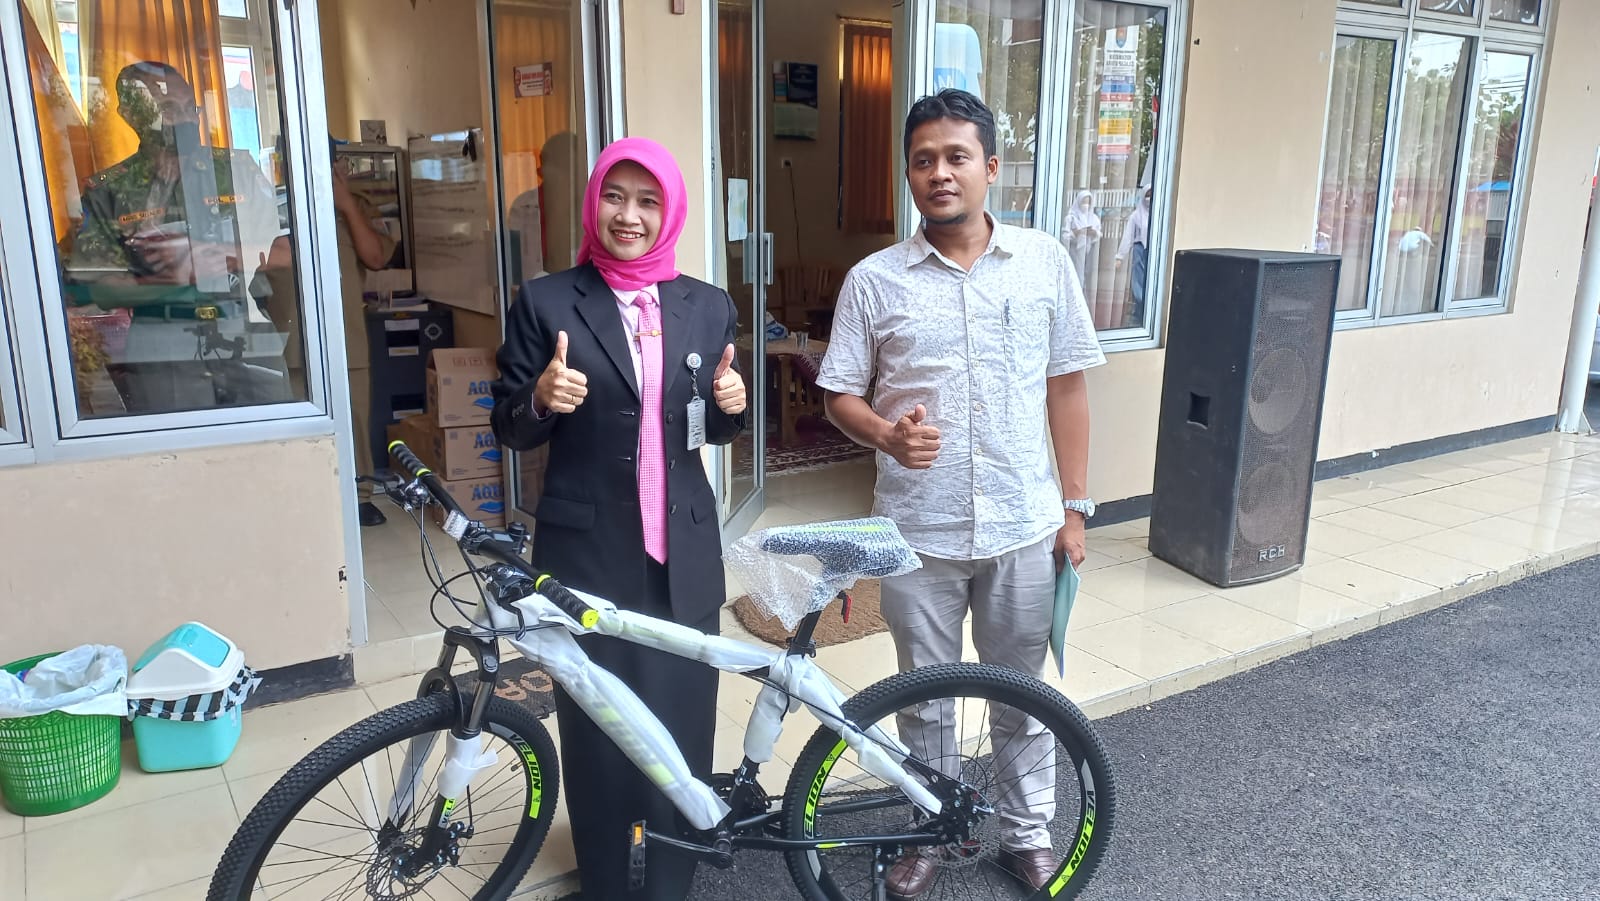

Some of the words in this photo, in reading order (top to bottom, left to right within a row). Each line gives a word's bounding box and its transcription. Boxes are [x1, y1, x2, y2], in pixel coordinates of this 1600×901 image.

[468, 380, 491, 396] AQ
[474, 432, 496, 448] AQ
[509, 733, 541, 791] VELION
[804, 766, 827, 838] ELION
[1070, 790, 1095, 870] VELION
